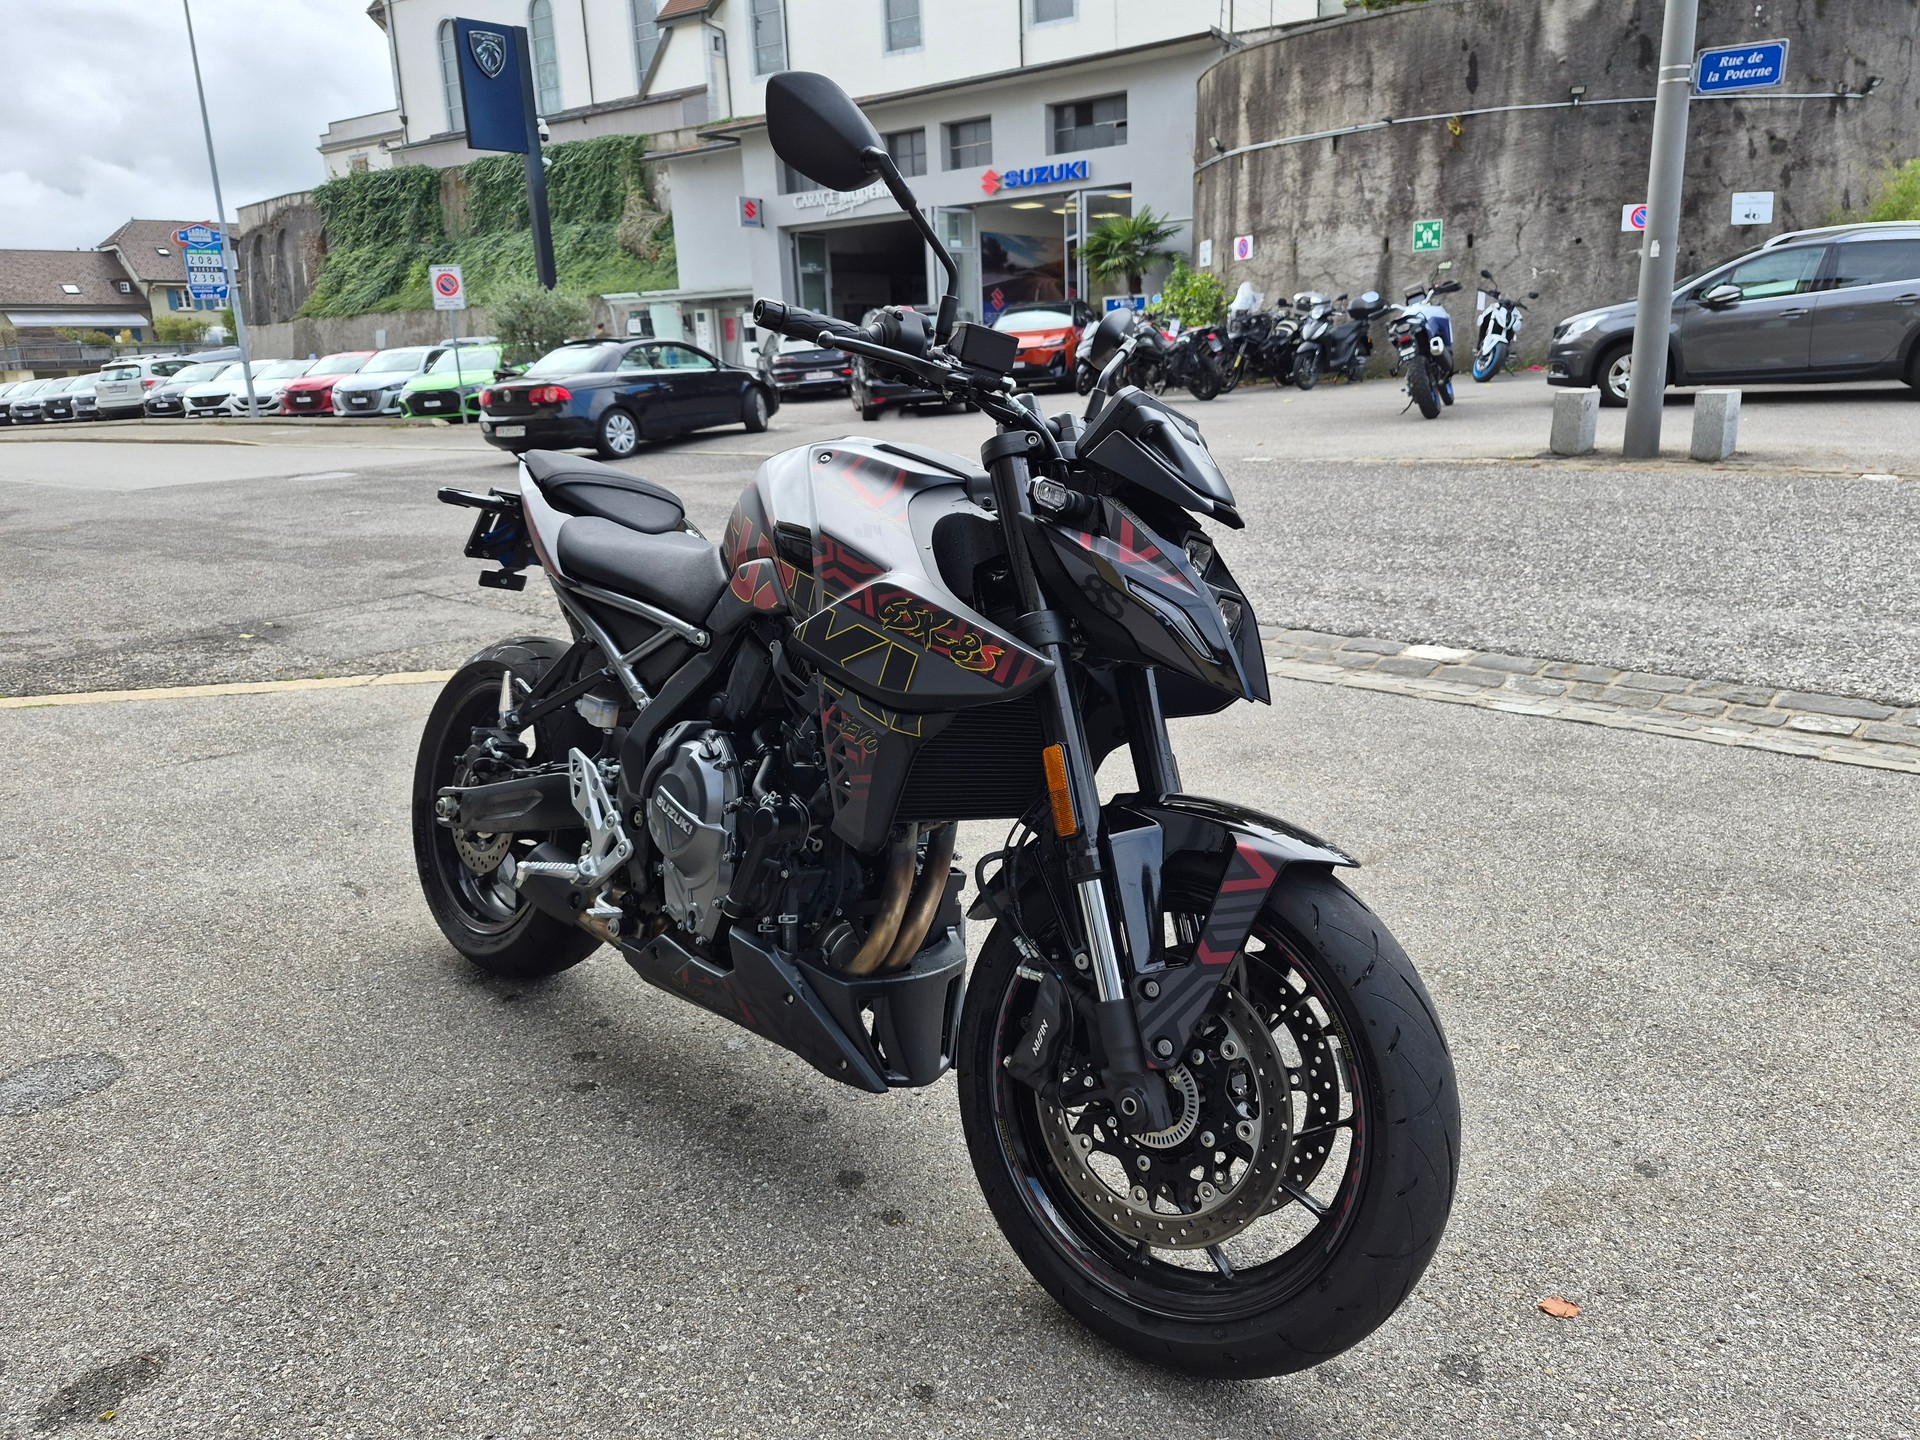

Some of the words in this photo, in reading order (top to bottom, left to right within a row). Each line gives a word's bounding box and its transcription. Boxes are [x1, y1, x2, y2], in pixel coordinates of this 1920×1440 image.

[1706, 71, 1720, 83] la
[1724, 66, 1773, 81] Poterne
[1719, 56, 1744, 68] Rue
[1747, 52, 1764, 64] de
[1003, 160, 1088, 189] SUZUKI
[793, 191, 839, 209] GARAGE
[1108, 498, 1152, 535] SUZUKI
[878, 598, 1006, 672] GSX-8S
[656, 794, 693, 835] SUZUKI
[1329, 1010, 1355, 1060] SUZUKI
